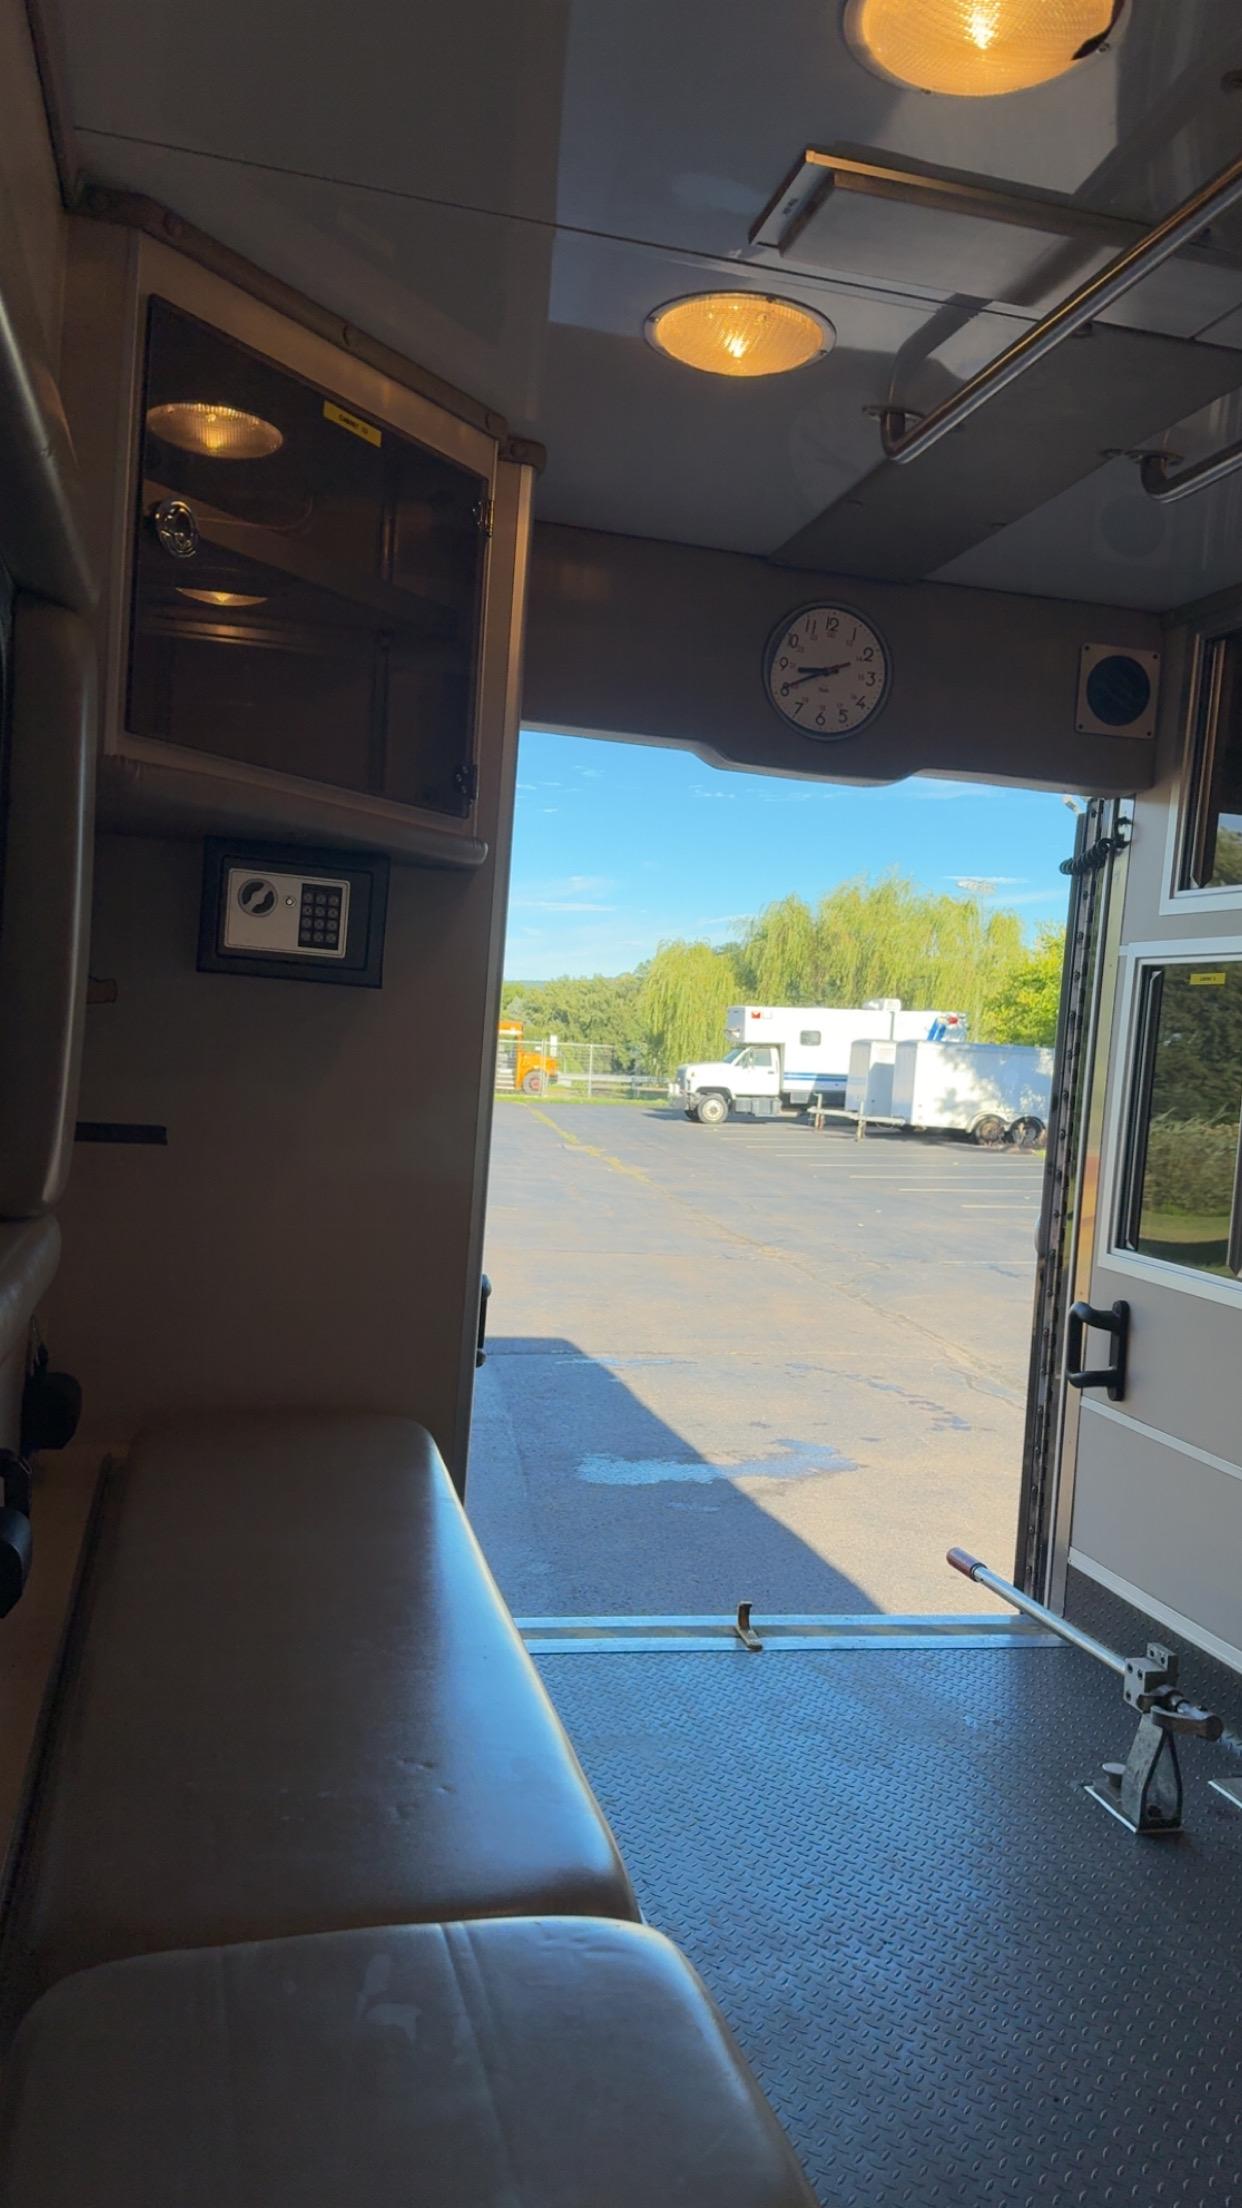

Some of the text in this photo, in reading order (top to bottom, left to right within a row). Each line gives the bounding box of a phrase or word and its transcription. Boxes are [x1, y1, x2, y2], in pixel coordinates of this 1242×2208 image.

[805, 619, 817, 634] 11
[825, 616, 840, 632] 12
[852, 627, 857, 641] 1
[863, 647, 874, 662] 2
[779, 656, 789, 671] 9
[865, 671, 876, 687] 3
[780, 681, 790, 697] 8
[793, 701, 804, 715] 7
[856, 695, 866, 710] 4
[815, 711, 826, 726] 6
[838, 709, 849, 724] 5
